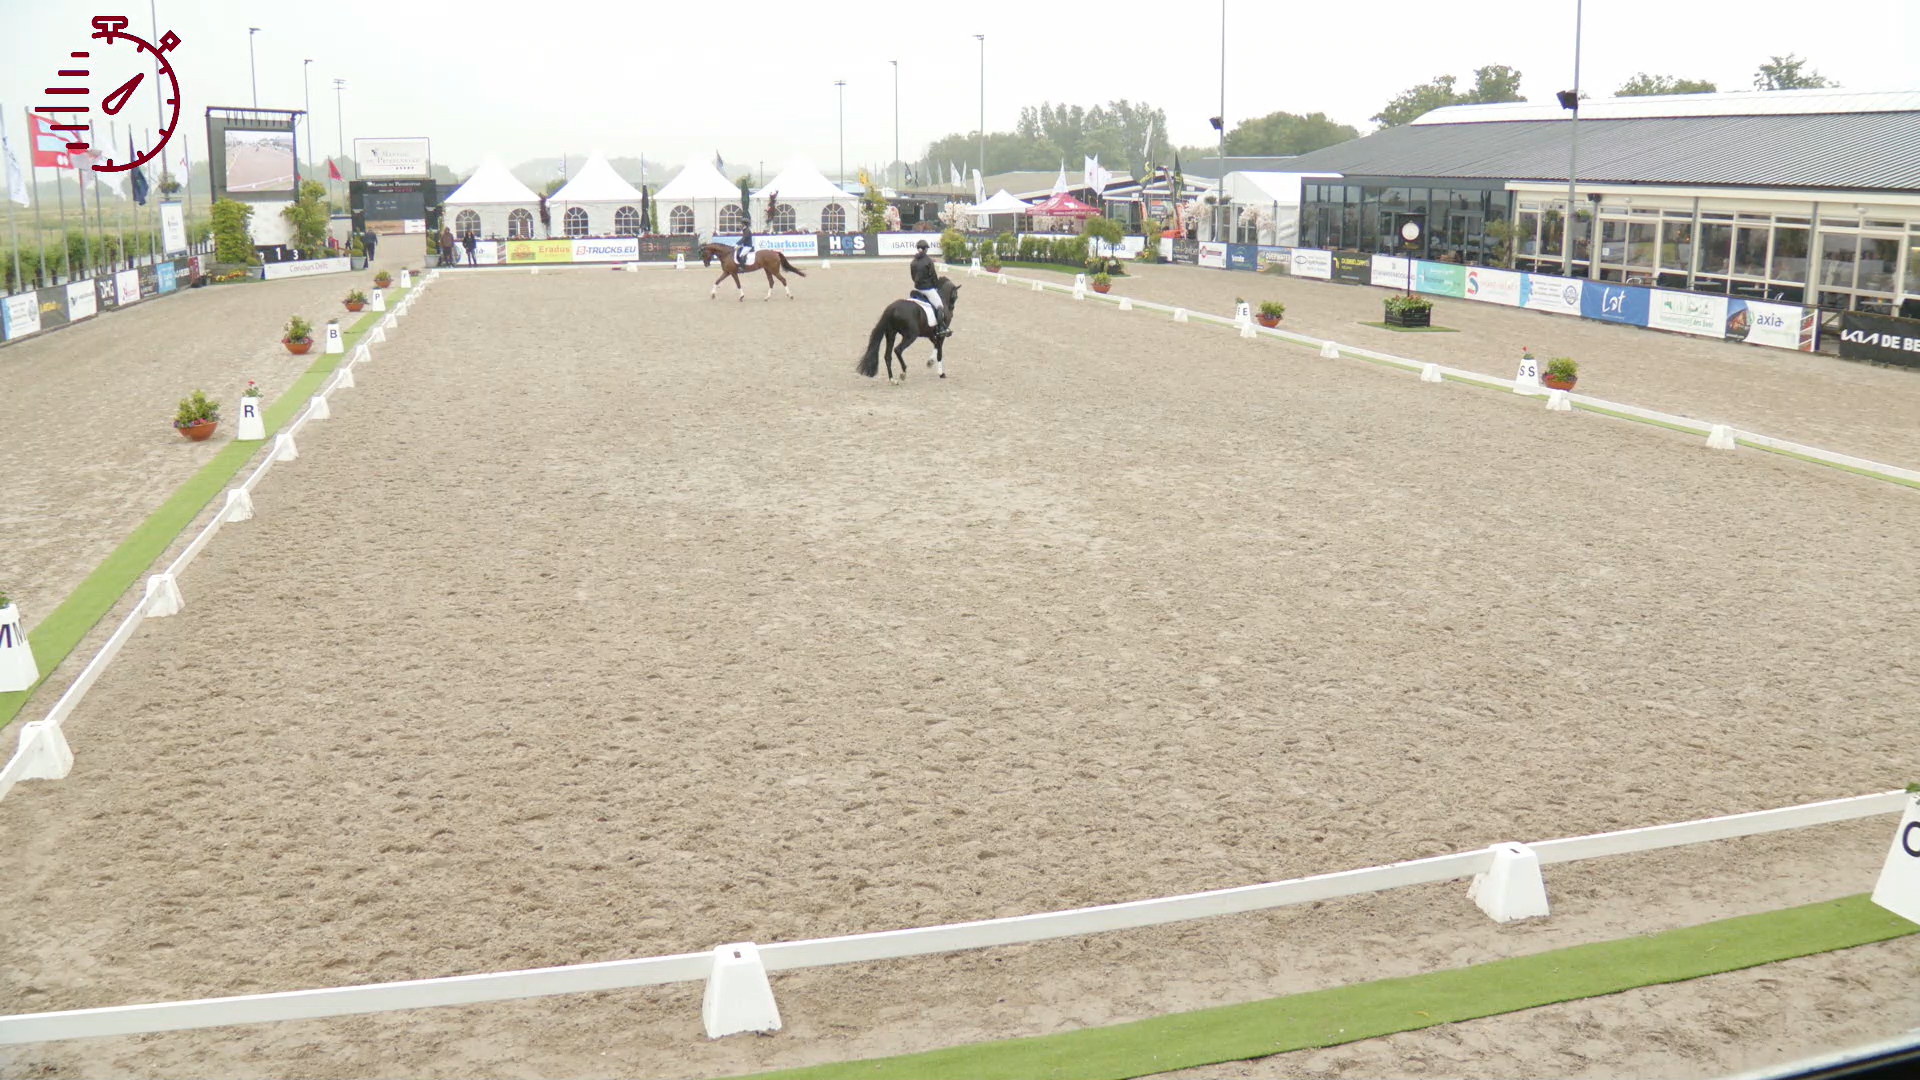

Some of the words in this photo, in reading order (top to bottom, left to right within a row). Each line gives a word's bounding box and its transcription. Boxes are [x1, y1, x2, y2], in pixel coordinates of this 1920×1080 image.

[829, 235, 866, 249] HGS
[276, 248, 281, 260] 1
[293, 249, 299, 260] 3
[1243, 307, 1248, 316] E
[1757, 312, 1785, 327] axia
[330, 329, 338, 338] B
[1841, 329, 1880, 346] KIA
[1881, 334, 1902, 350] DE
[1528, 366, 1535, 377] S
[244, 405, 254, 418] R
